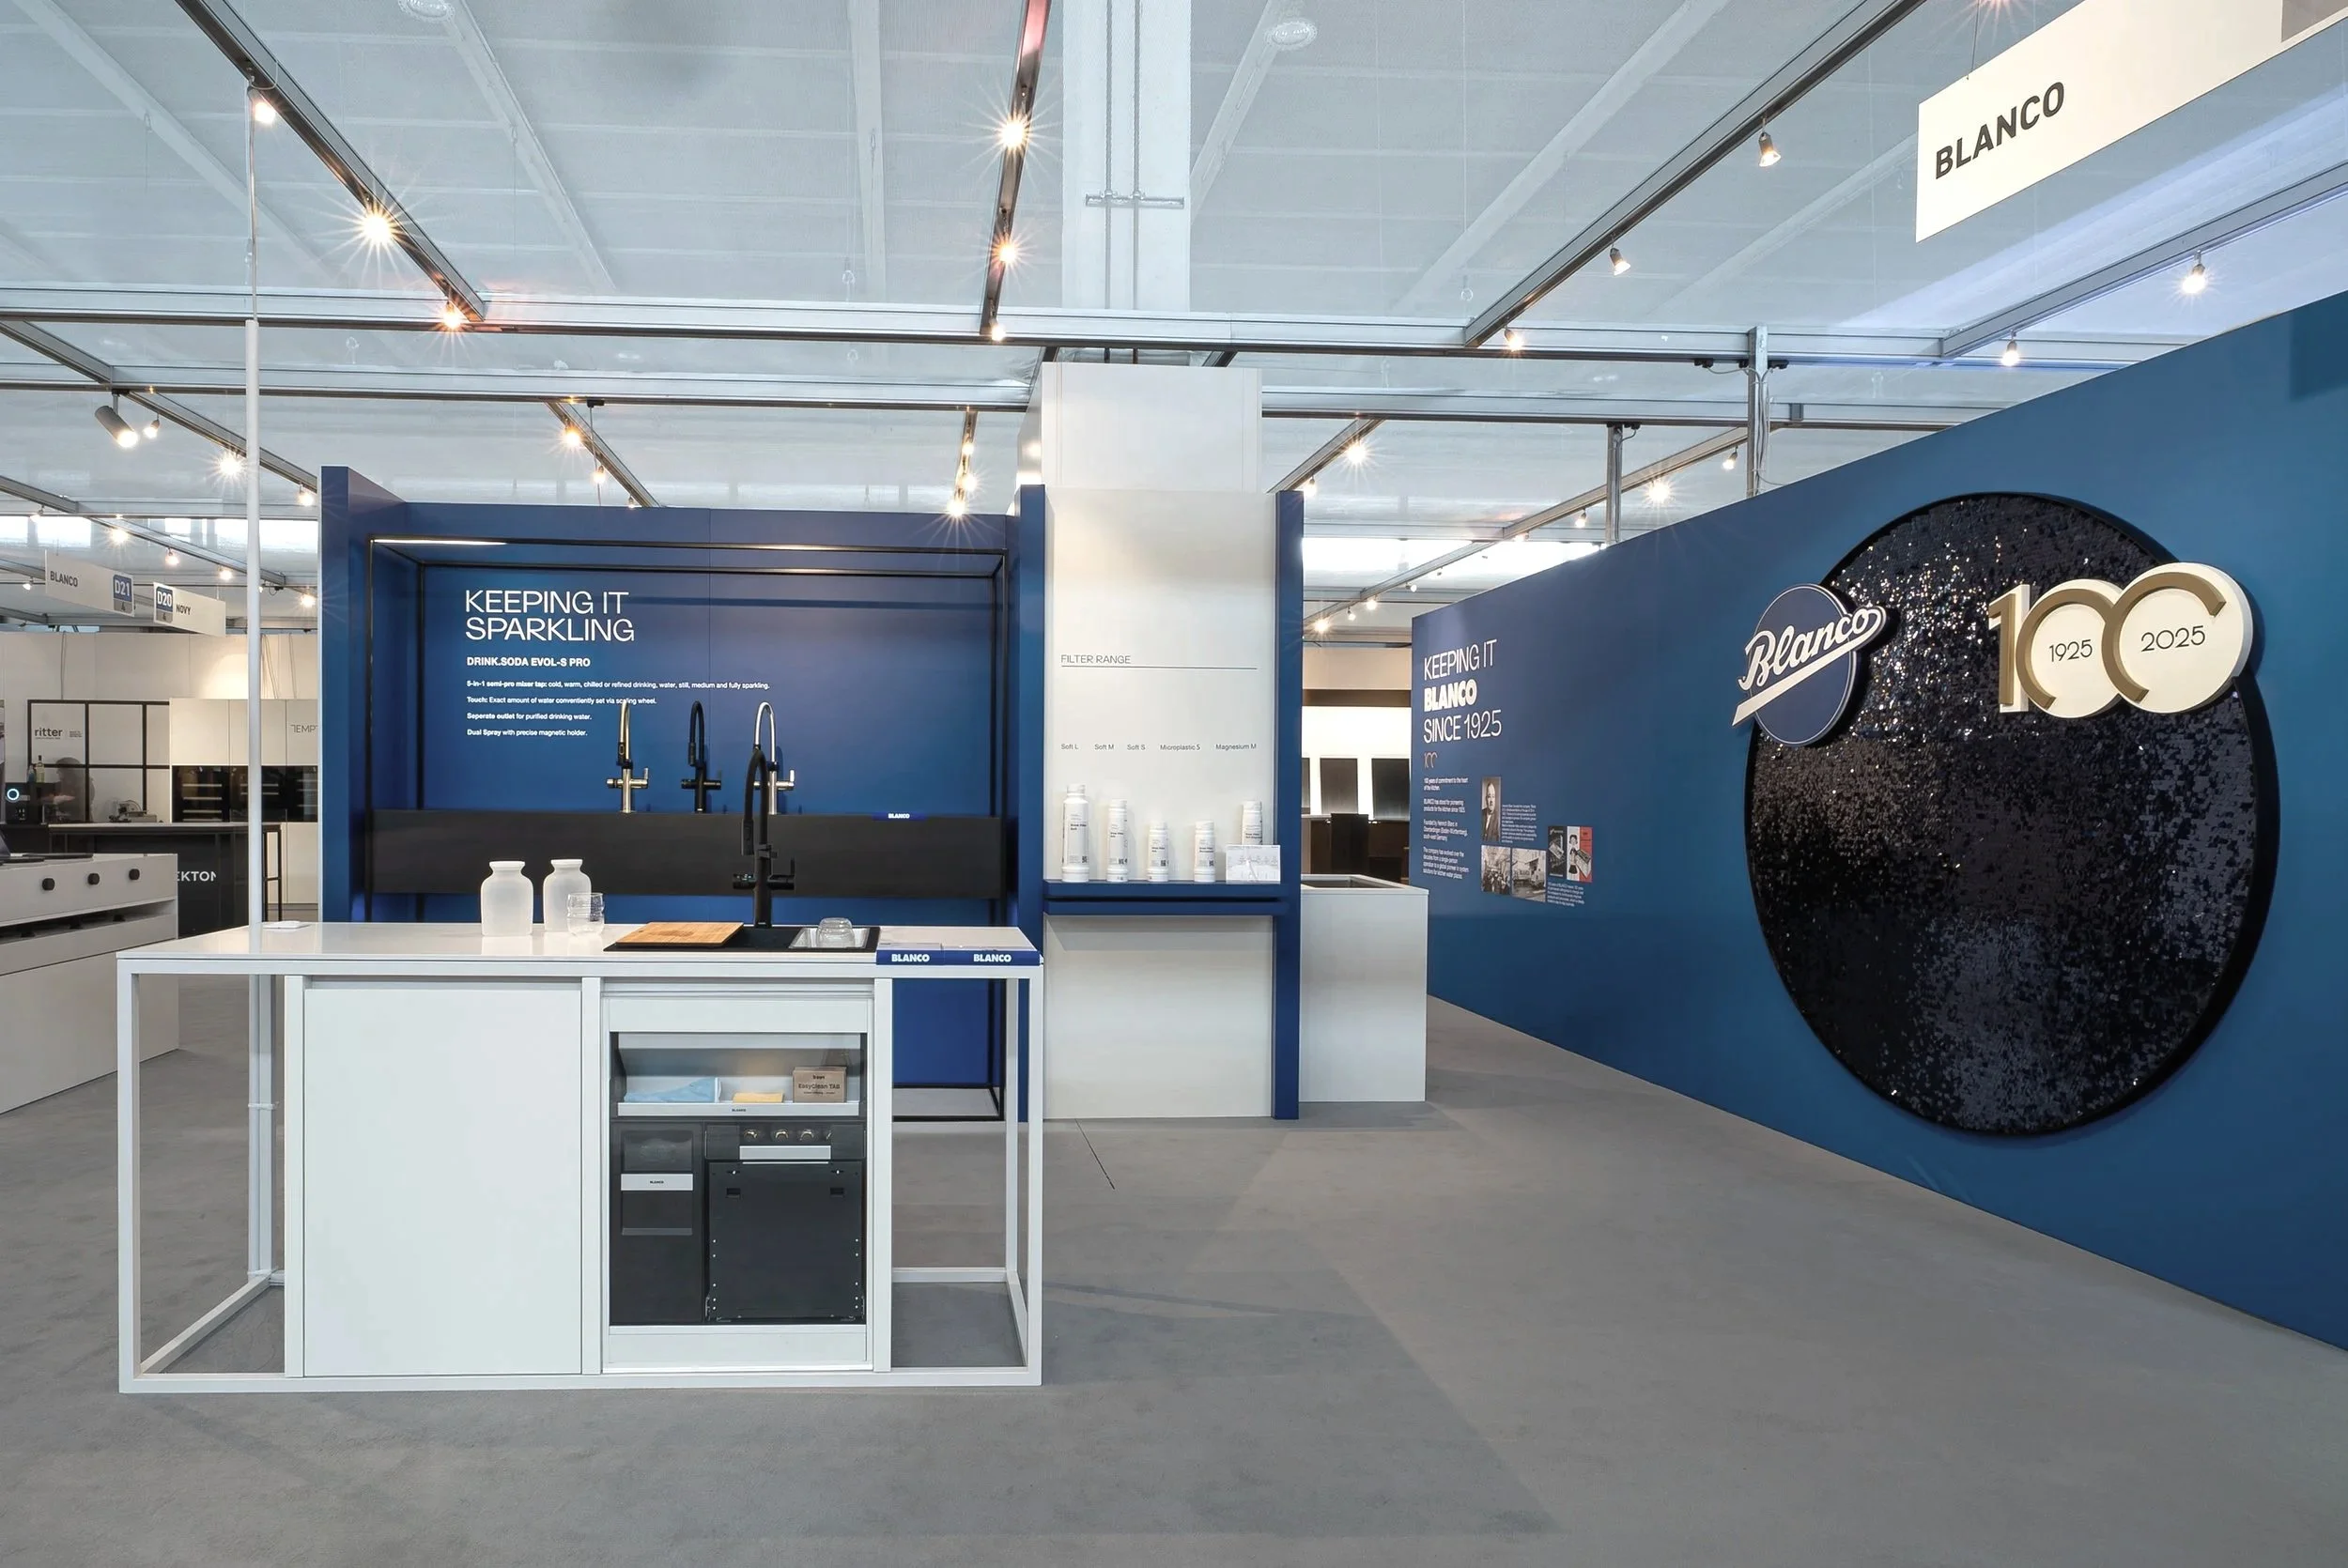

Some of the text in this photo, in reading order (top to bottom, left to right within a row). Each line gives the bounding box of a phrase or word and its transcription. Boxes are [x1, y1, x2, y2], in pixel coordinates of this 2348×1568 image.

[1935, 81, 2065, 180] BLANCO
[50, 570, 79, 588] BLANCO
[114, 578, 131, 597] D21
[157, 591, 173, 607] D20
[465, 590, 629, 615] KEEPING IT
[176, 604, 192, 616] NOVY
[465, 616, 635, 642] SPARKLING
[2140, 624, 2206, 653] 2025
[1735, 602, 1887, 706] Blanco
[2048, 638, 2093, 663] 1925
[467, 656, 591, 668] DRINK.SODA EVOL-S PRO
[1060, 653, 1131, 665] FILTER RANGE
[1424, 638, 1498, 681] KEEPING IT
[728, 682, 741, 691] fully
[488, 696, 506, 704] Exact
[1424, 679, 1477, 712] BLANCO
[548, 713, 573, 722] drinking
[34, 727, 63, 737] ritter
[483, 729, 502, 737] Spray
[516, 729, 538, 737] precise
[538, 729, 565, 738] magnetic
[1423, 709, 1503, 744] SINCE 1925
[1160, 744, 1196, 752] Microplastic
[1215, 744, 1250, 752] Magnesium
[891, 953, 931, 962] BLANCO
[973, 953, 1012, 962] BLANCO
